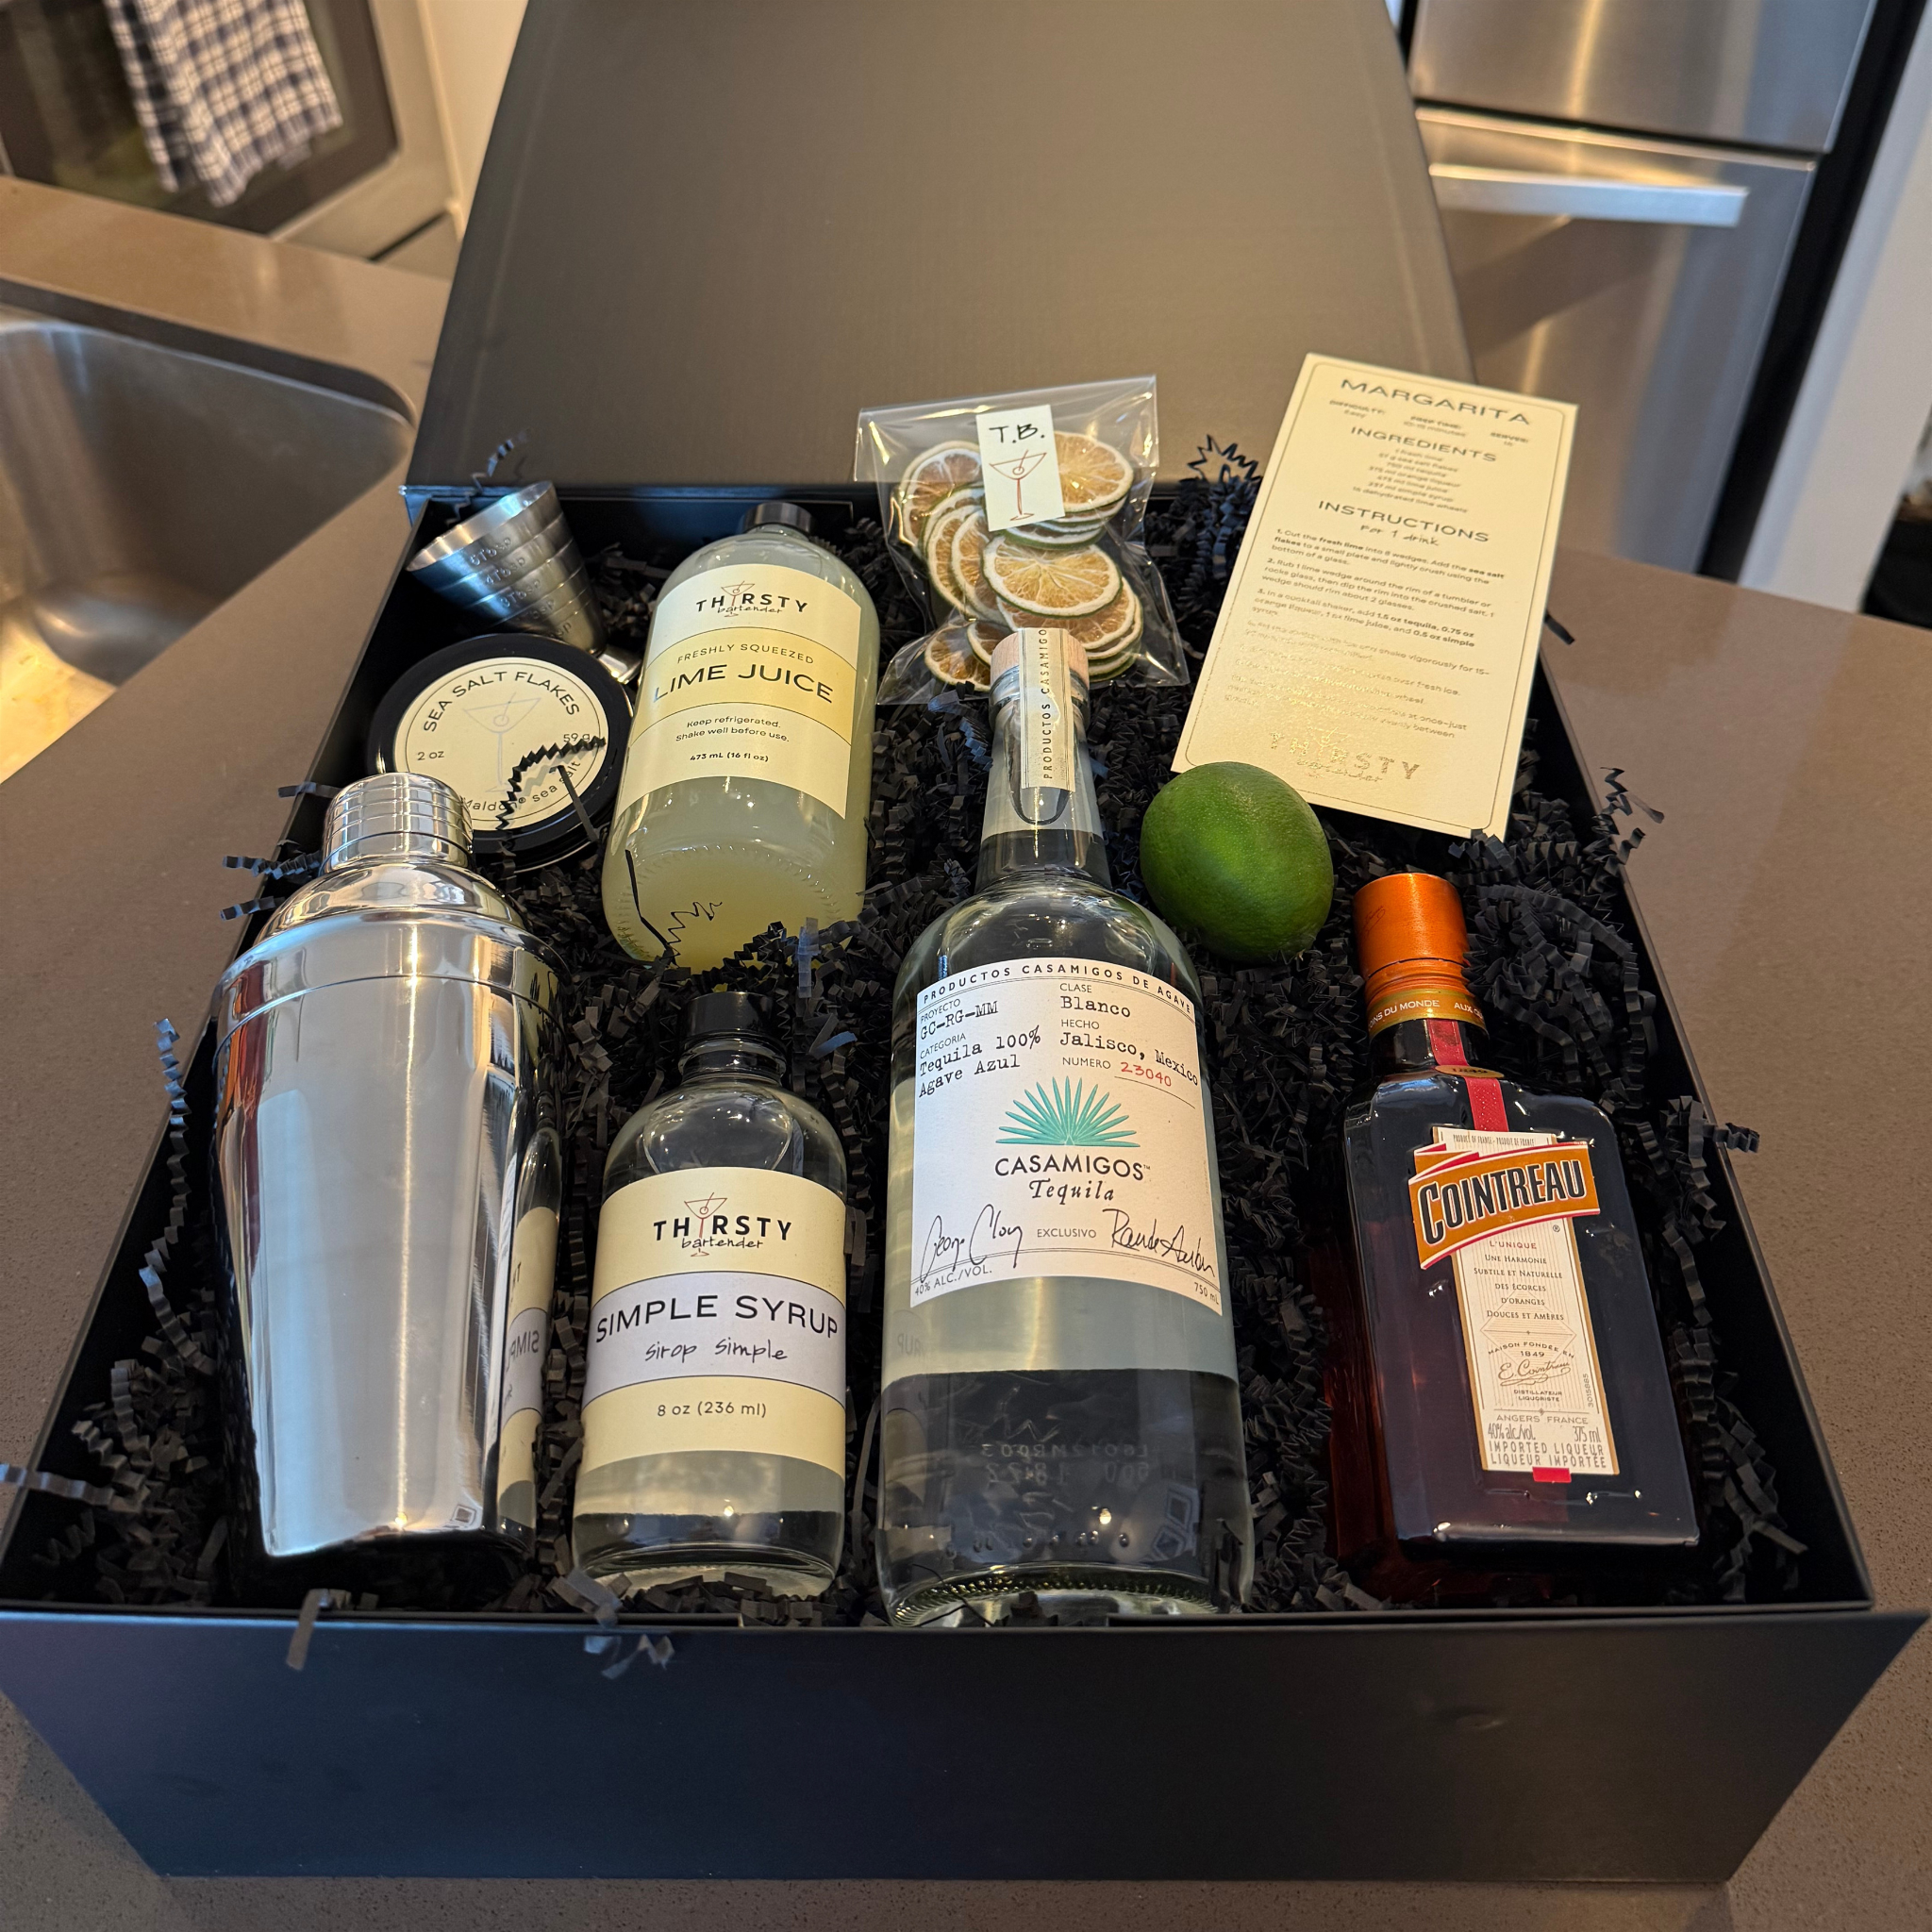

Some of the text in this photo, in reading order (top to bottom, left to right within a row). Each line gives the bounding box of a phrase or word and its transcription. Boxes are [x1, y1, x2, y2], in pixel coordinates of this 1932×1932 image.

[1340, 378, 1531, 425] MARGARITA
[989, 424, 1044, 443] T.B.
[1350, 426, 1497, 462] INGREDIENTS
[1317, 499, 1490, 542] INSTRUCTIONS
[677, 643, 813, 664] FRESHLY SQUEEZED
[653, 664, 833, 704] LIME JUICE
[424, 672, 579, 732] SEA SALT FLAKES
[1039, 628, 1053, 779] PRODUCTOS CASAMIGO
[687, 716, 781, 728] Keep refrigerated.
[563, 733, 578, 742] 59
[675, 730, 706, 741] Shake
[731, 727, 766, 736] before
[769, 732, 790, 741] use.
[417, 751, 444, 760] 2 oz
[690, 753, 707, 761] 473
[532, 785, 558, 803] sea
[924, 964, 1191, 1014] PRODUCTOS CASAMIGOS DE AGAVE
[1059, 983, 1091, 993] CLASE
[920, 999, 960, 1024] PROYECTO
[1060, 995, 1130, 1018] Blanco
[1384, 1006, 1397, 1017] DU
[1399, 1000, 1440, 1011] MONDE
[1455, 1002, 1474, 1013] AUX
[1060, 1019, 1100, 1029] HECHO
[920, 1033, 966, 1059] CATEGORIA
[920, 1024, 1041, 1076] Tequila 100%
[1059, 1032, 1198, 1086] Jalisco, Mexico
[919, 1054, 1020, 1098] Agave Azul
[1062, 1057, 1172, 1087] NUMERO 23040
[1029, 1178, 1114, 1206] Tequila
[1417, 1160, 1587, 1244] COINTREAU
[681, 1236, 763, 1249] bartender
[1037, 1228, 1097, 1238] EXCLUSIVO
[1490, 1241, 1537, 1249] L'UNIQUE
[914, 1265, 992, 1295] 40% ALC./VOL.
[1193, 1282, 1208, 1297] 750
[596, 1295, 838, 1342] SIMPLE SYRUP
[644, 1337, 788, 1363] sirop simple
[658, 1401, 767, 1418] 8 oz (236 ml)
[1496, 1414, 1589, 1424] ANGERS FRANCE
[1488, 1423, 1505, 1439] 40%
[1573, 1425, 1588, 1442] 375
[1490, 1441, 1604, 1456] IMPORTED LIQUEUR
[1491, 1453, 1607, 1468] LIQUEUR IMPORTÉE
